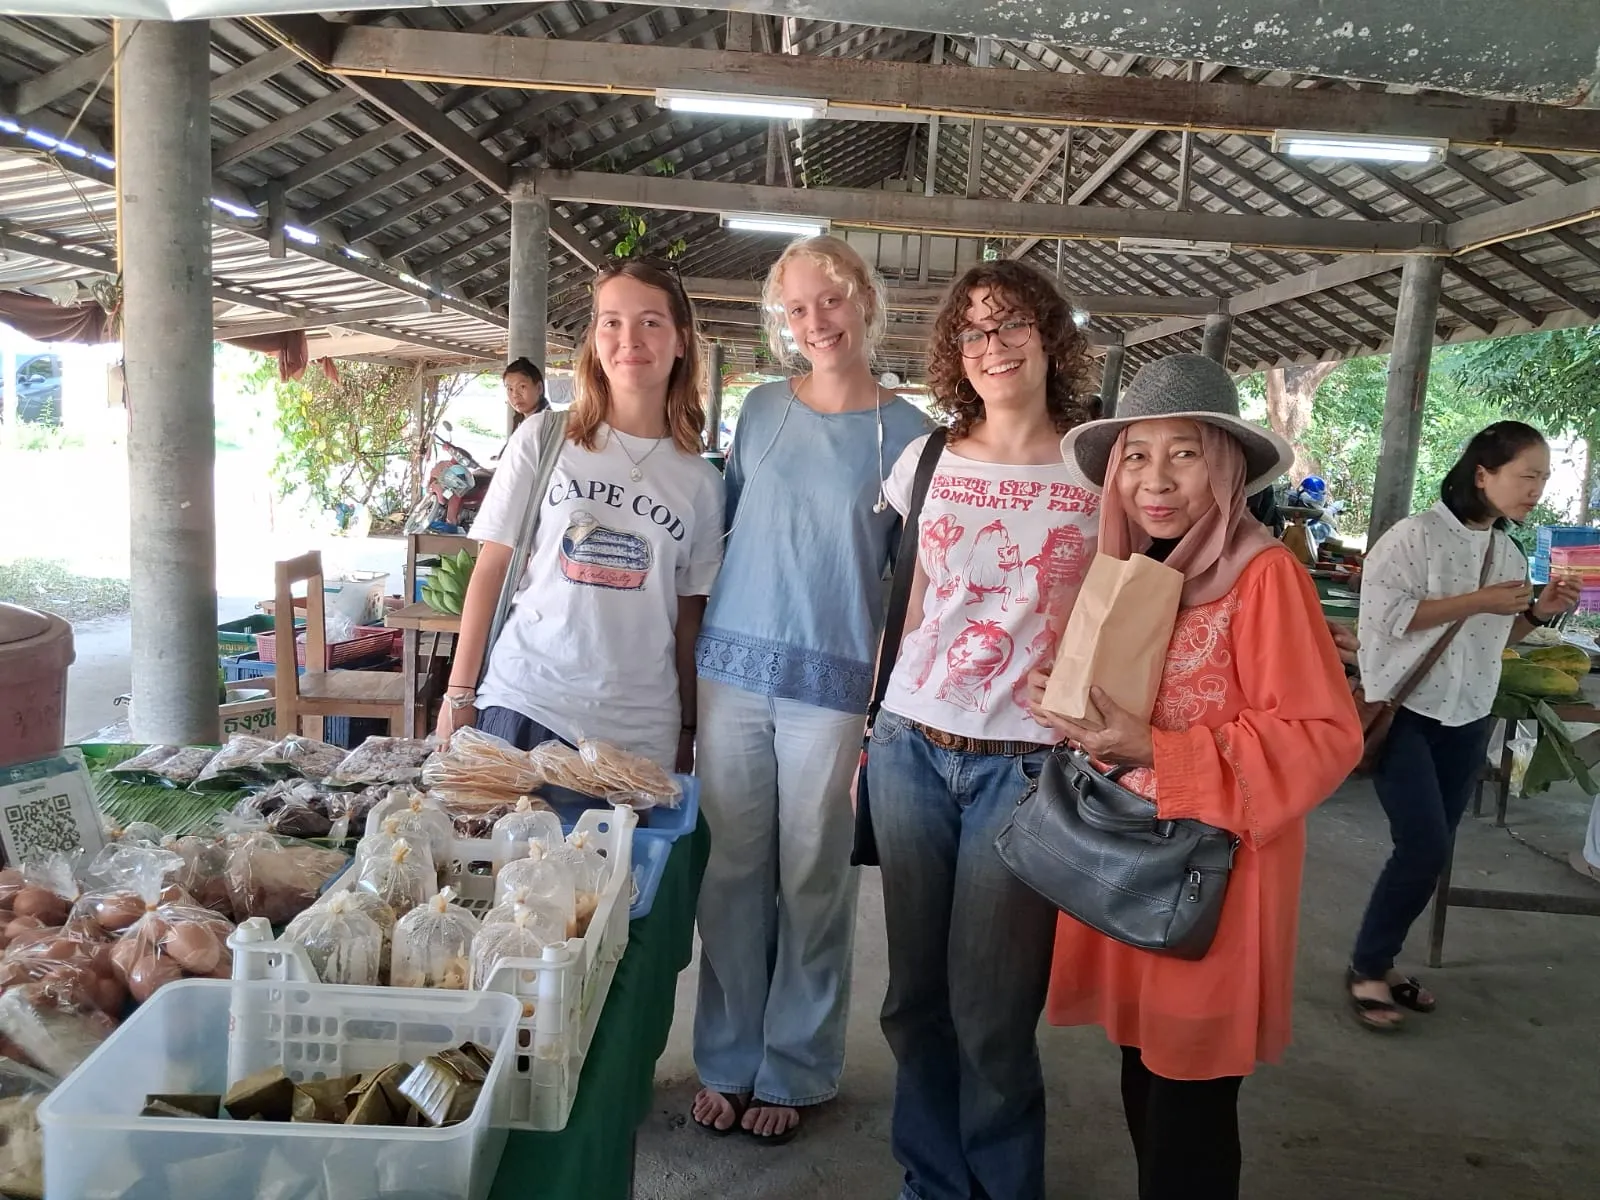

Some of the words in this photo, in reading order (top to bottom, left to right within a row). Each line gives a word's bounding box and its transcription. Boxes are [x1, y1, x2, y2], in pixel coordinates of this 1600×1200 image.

[931, 488, 1033, 511] COMMUNITY
[1047, 500, 1096, 516] FARM
[999, 480, 1046, 497] SKY
[549, 480, 624, 507] CAPE
[632, 495, 685, 541] COD
